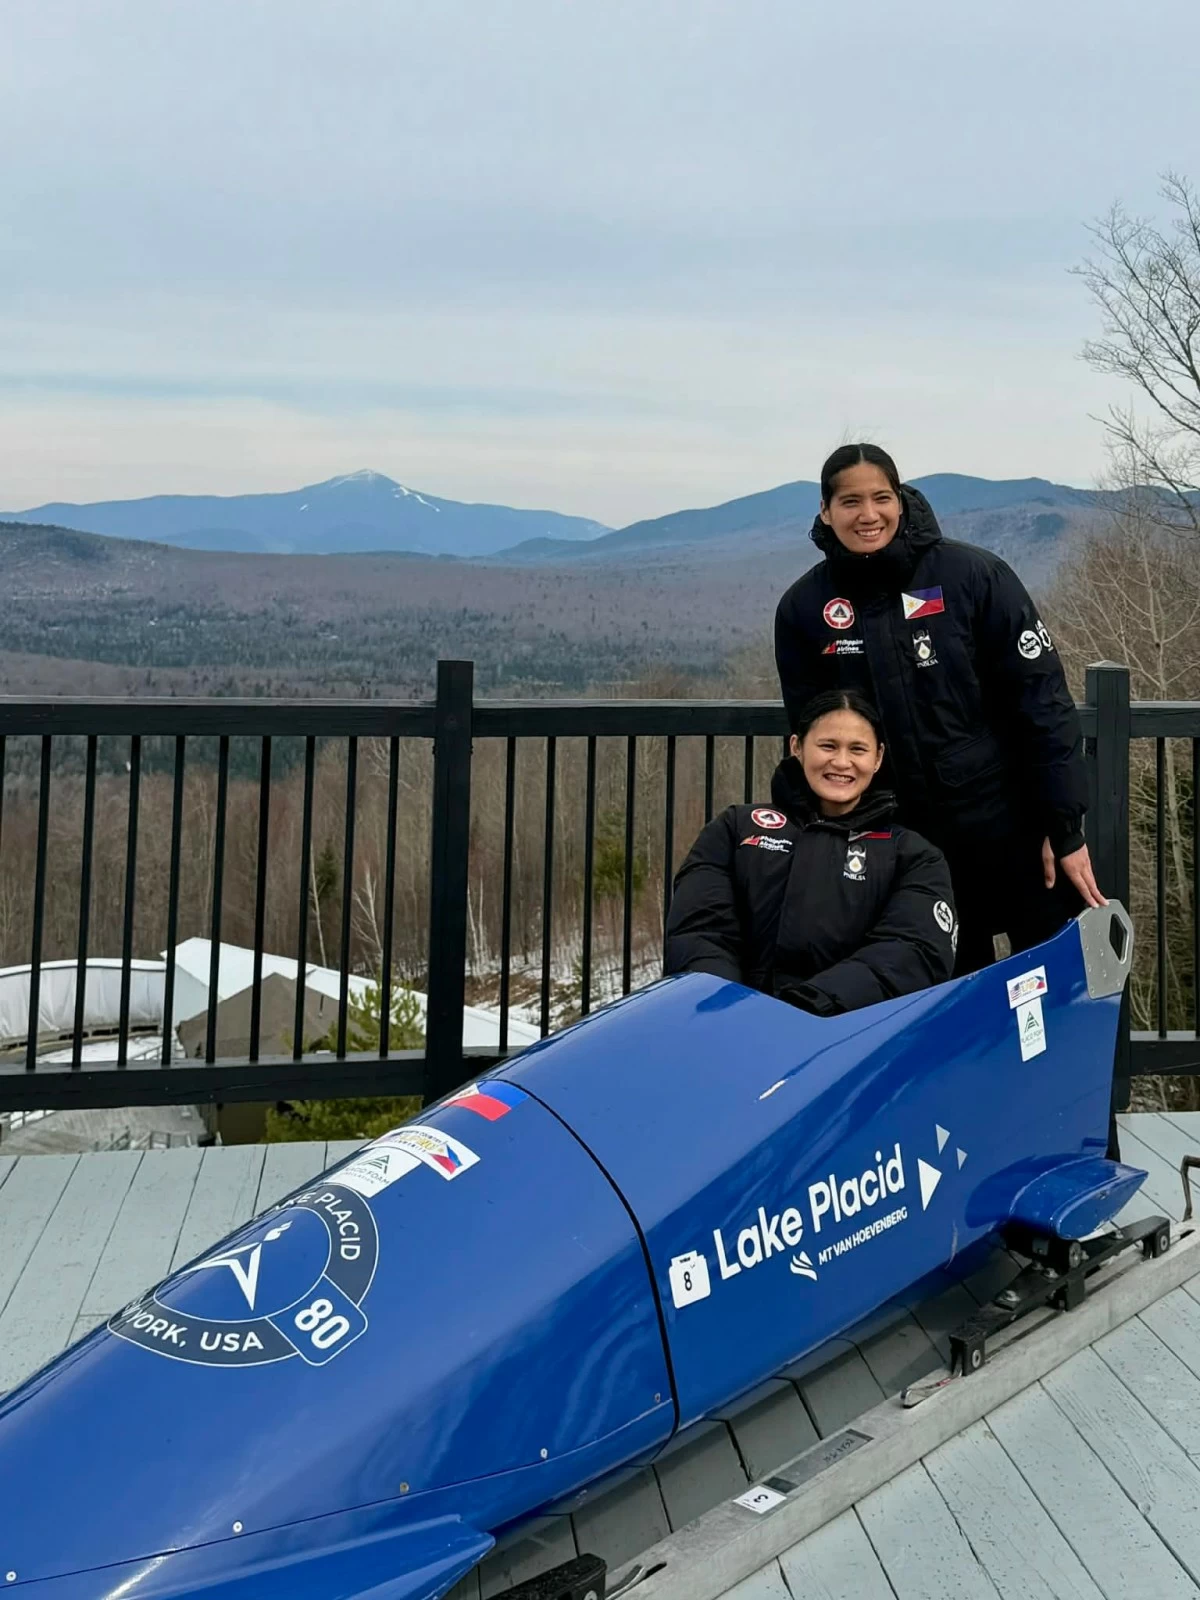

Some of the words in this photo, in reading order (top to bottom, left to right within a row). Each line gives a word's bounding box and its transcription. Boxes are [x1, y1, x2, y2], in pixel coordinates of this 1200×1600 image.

[314, 1192, 361, 1261] PLACID
[713, 1206, 804, 1280] Lake
[808, 1142, 905, 1233] Placid
[818, 1250, 833, 1266] MT
[832, 1236, 853, 1258] VAN
[852, 1206, 908, 1246] HOEVENBERG
[683, 1270, 693, 1292] 8
[127, 1306, 188, 1348] YORK,
[200, 1331, 264, 1352] USA
[294, 1298, 350, 1350] 80
[753, 1494, 769, 1503] 3
